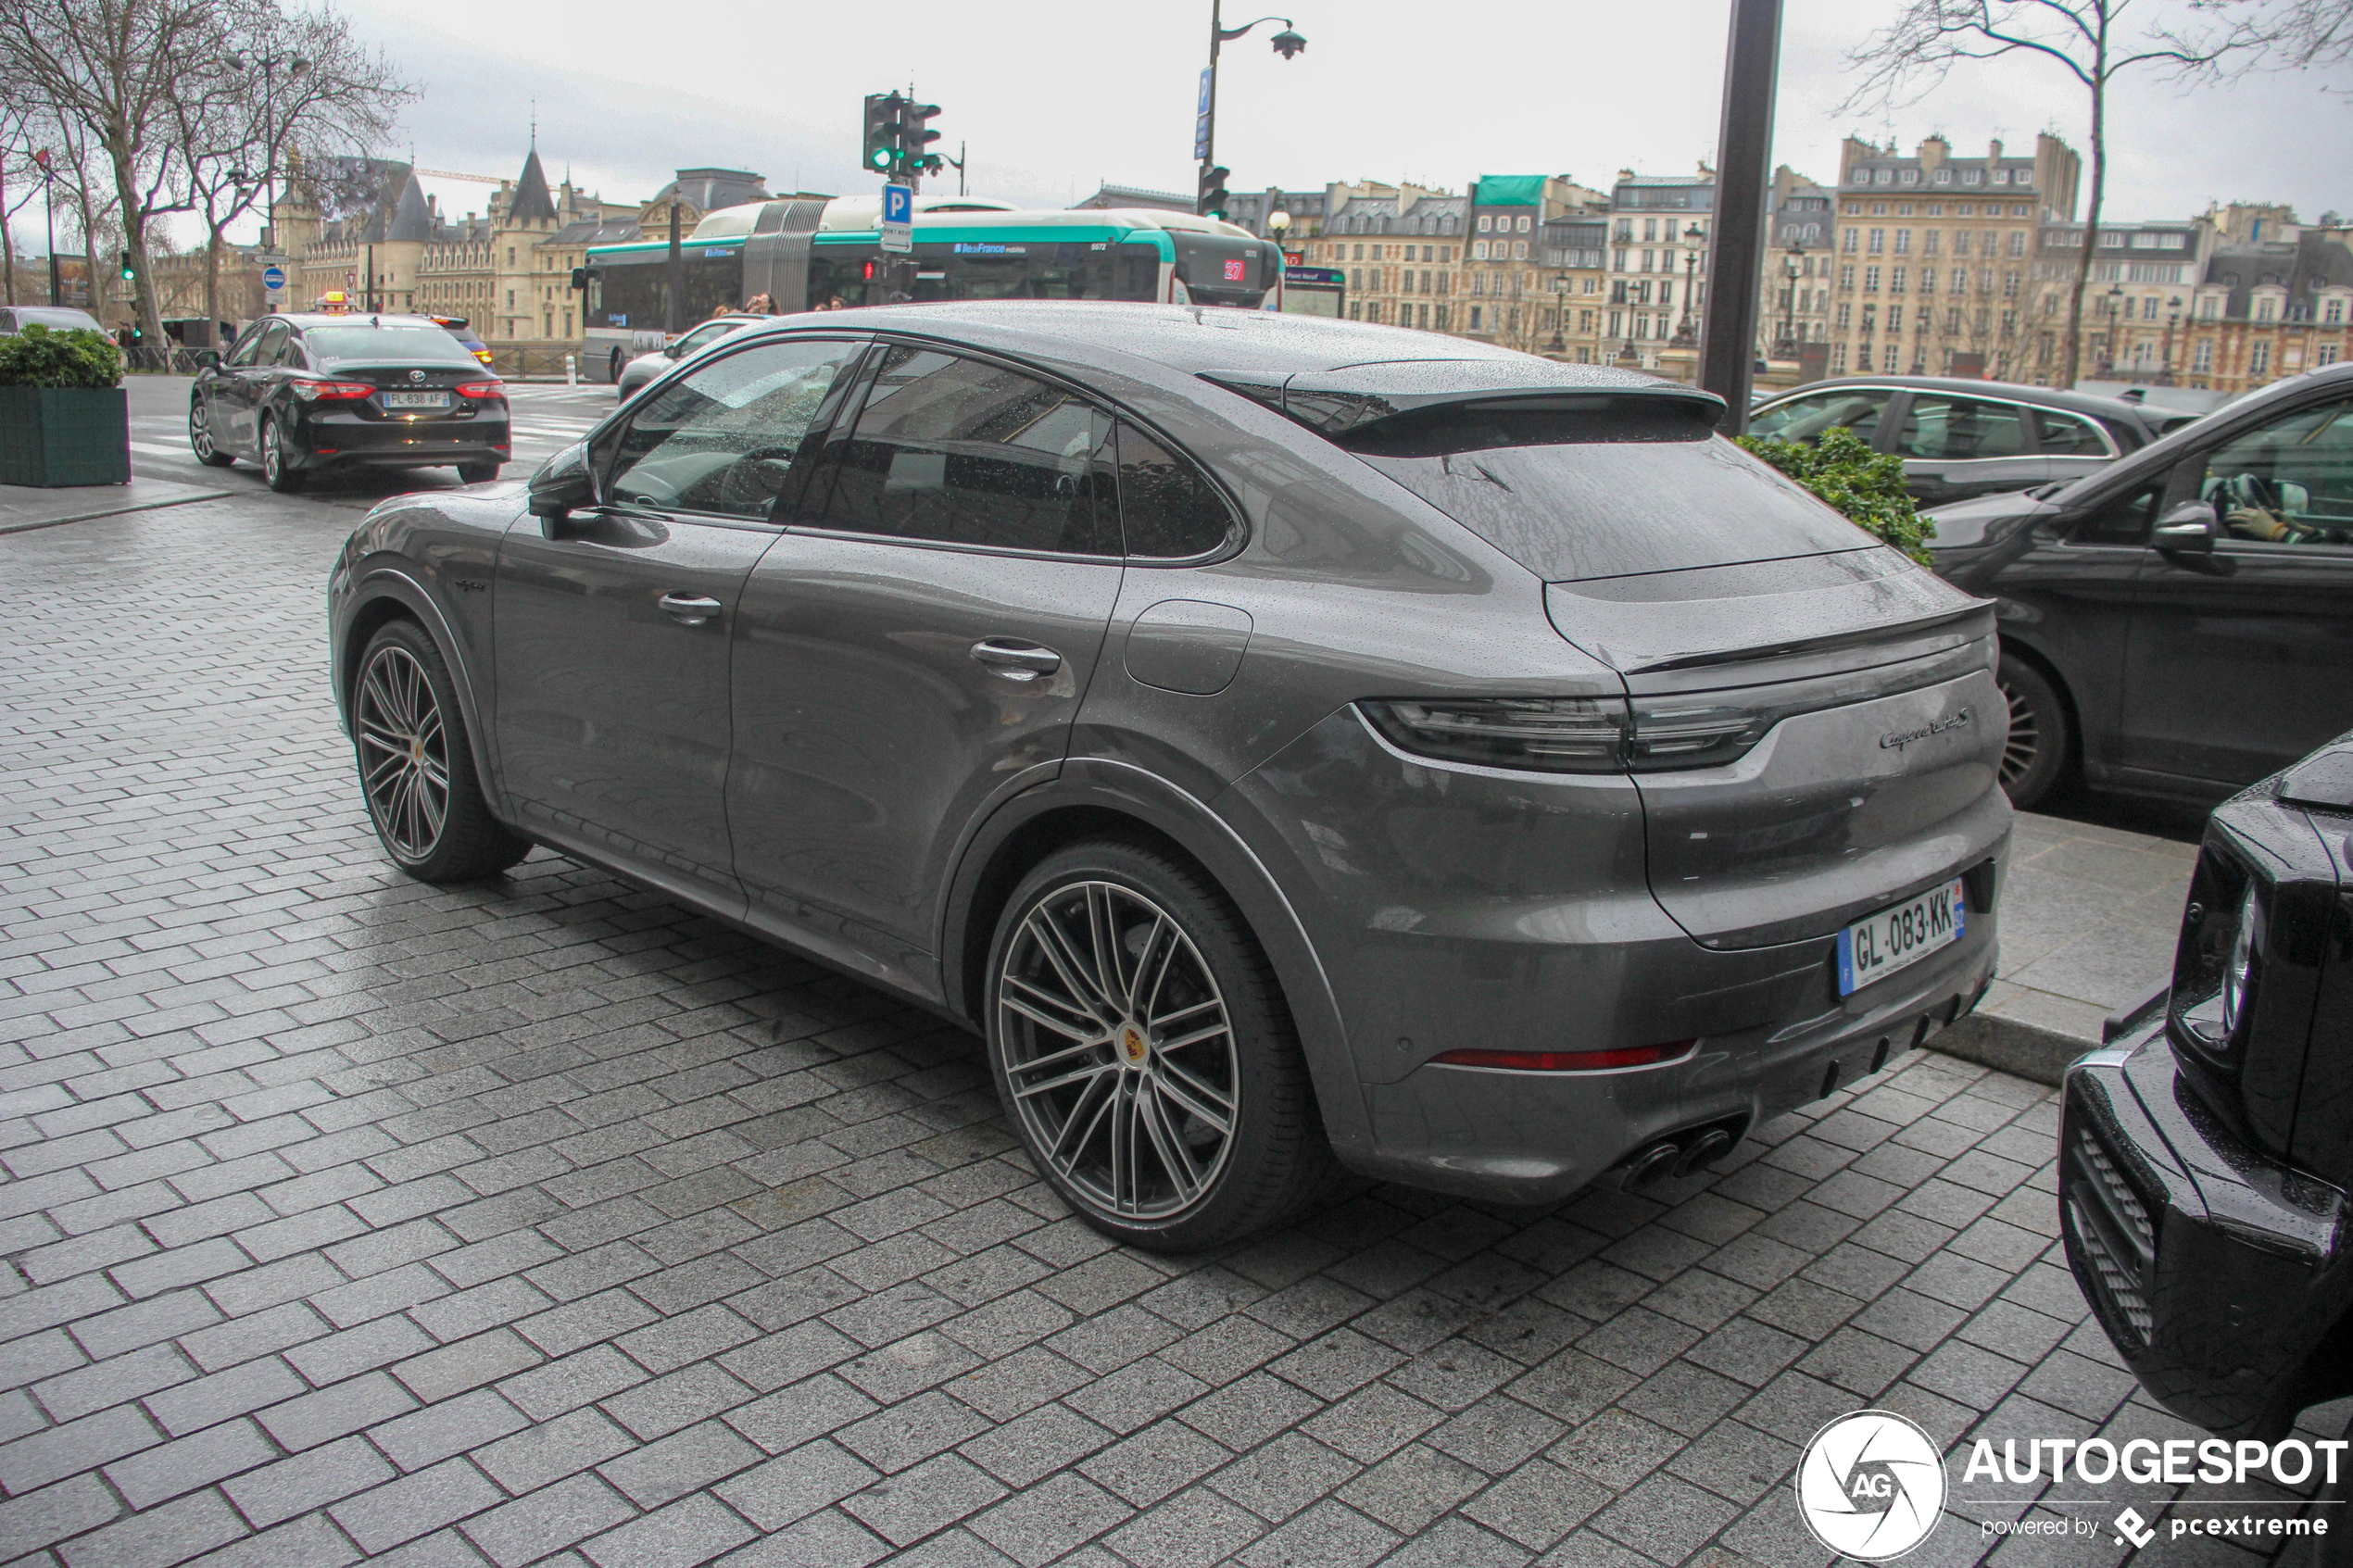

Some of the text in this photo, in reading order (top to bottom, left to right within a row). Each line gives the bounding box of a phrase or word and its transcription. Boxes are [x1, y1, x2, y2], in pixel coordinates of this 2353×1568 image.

[891, 192, 905, 218] P
[1090, 243, 1107, 251] 5572
[1224, 262, 1242, 280] 27
[391, 394, 440, 404] FL-638-AF
[1957, 708, 1969, 727] S
[1856, 888, 1953, 972] GL-083-KK
